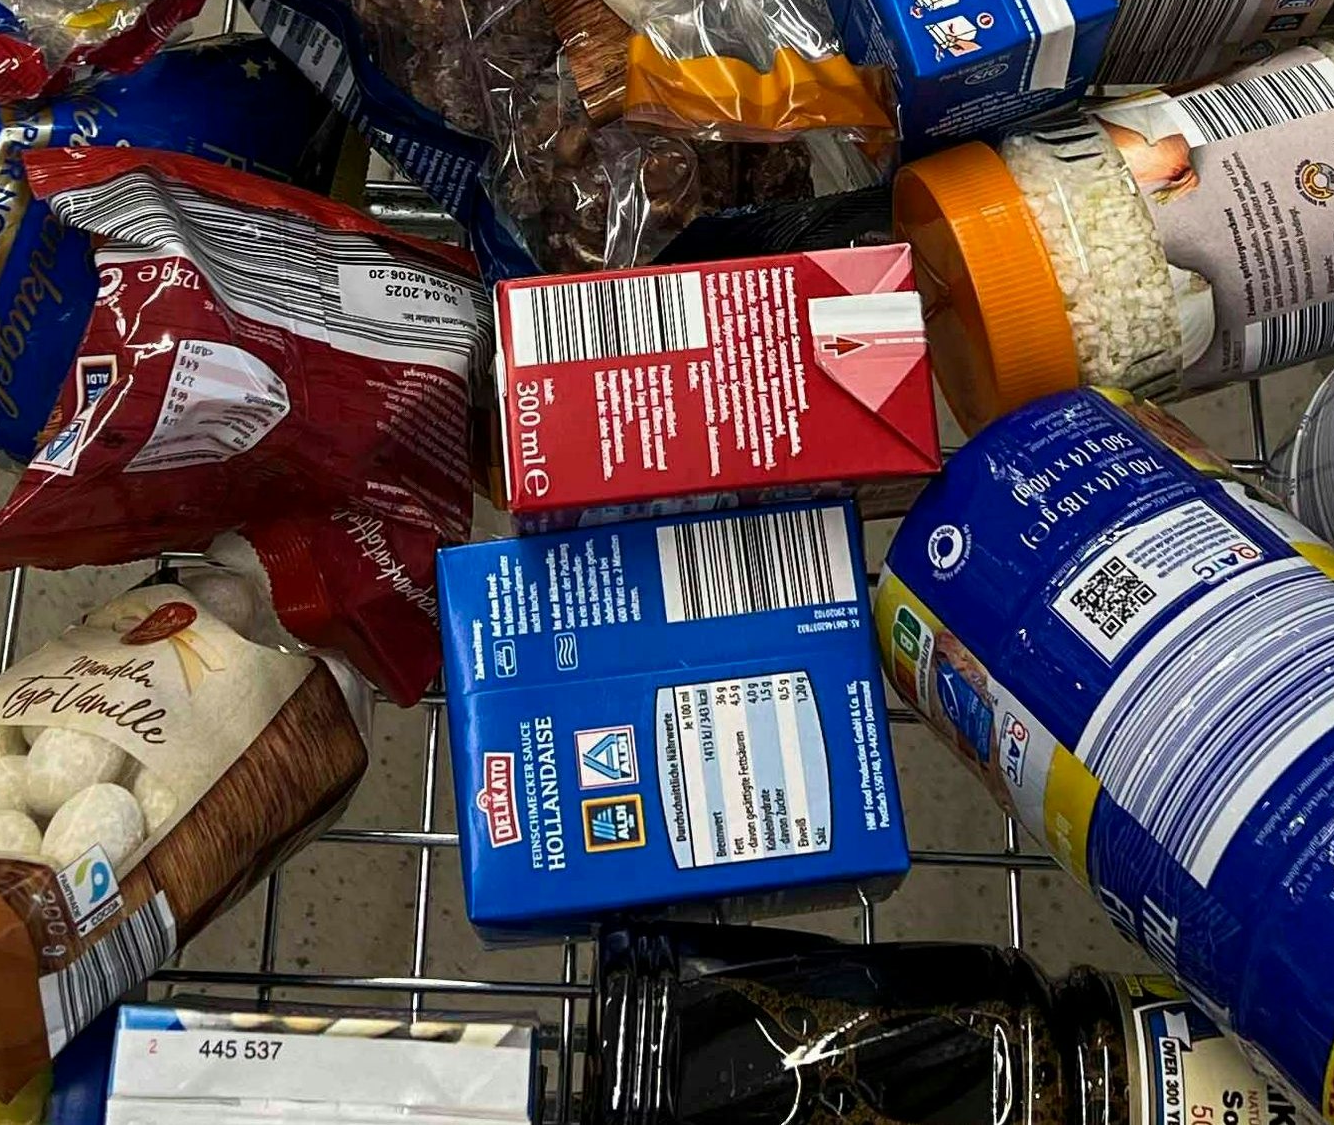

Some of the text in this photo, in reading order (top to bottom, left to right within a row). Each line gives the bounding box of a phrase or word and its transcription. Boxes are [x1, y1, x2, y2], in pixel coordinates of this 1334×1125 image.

[85, 372, 109, 385] ALDI
[514, 380, 541, 425] 300
[1057, 488, 1085, 518] 185
[68, 653, 155, 690] Mandeln
[2, 675, 167, 745] Typ Vanille
[682, 704, 691, 718] 100
[696, 689, 707, 708] kcal
[797, 683, 807, 703] 1,20
[860, 680, 870, 718] Dortmund
[616, 732, 634, 780] ALDI
[856, 748, 871, 791] Production
[520, 721, 542, 869] FEINSCHMECKER SAUCE
[535, 716, 565, 871] HOLLANDAISE
[663, 712, 687, 843] Durchschnittliche Nährwerte
[736, 730, 758, 850] davon gesättigte Fettsäuren
[492, 757, 517, 840] DELIKATO
[775, 788, 785, 816] Zucker
[617, 805, 630, 840] ALDI
[713, 810, 726, 858] Brennwert
[760, 788, 774, 852] Kohlenhydrate
[796, 818, 809, 846] Eiweiß
[815, 827, 826, 846] Salz
[733, 835, 744, 854] Fett
[88, 897, 120, 922] COCOA
[199, 1040, 282, 1059] 445 537
[1161, 1039, 1179, 1105] OVER 300
